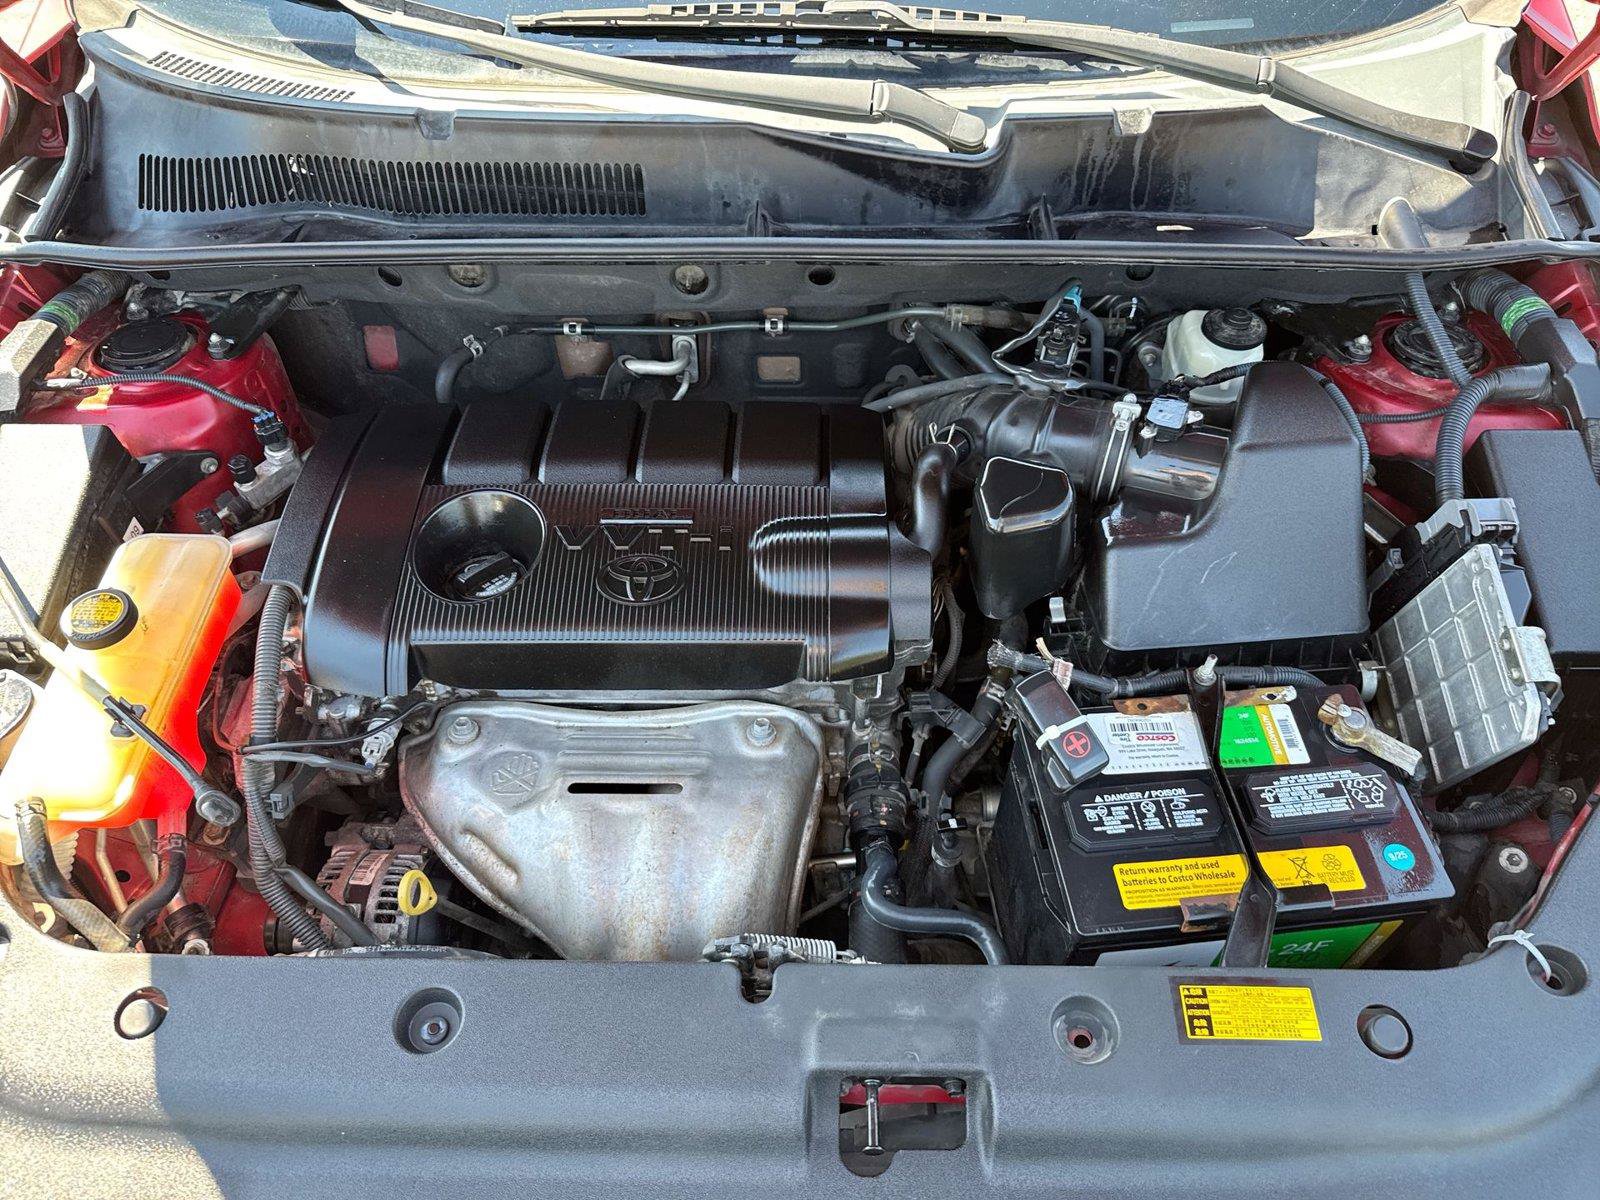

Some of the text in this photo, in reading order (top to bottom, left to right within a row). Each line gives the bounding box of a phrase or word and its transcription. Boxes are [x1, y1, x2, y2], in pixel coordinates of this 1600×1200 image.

[1261, 713, 1283, 755] AUTOMOTIVE
[1104, 792, 1142, 802] DANGER
[1151, 788, 1186, 798] POISON
[1388, 851, 1408, 861] 9/25
[1120, 860, 1220, 876] Return warranty and used
[1123, 870, 1236, 887] batteries to Costco Wholesale
[1328, 876, 1356, 884] RECYCLED
[1278, 939, 1334, 956] 24F
